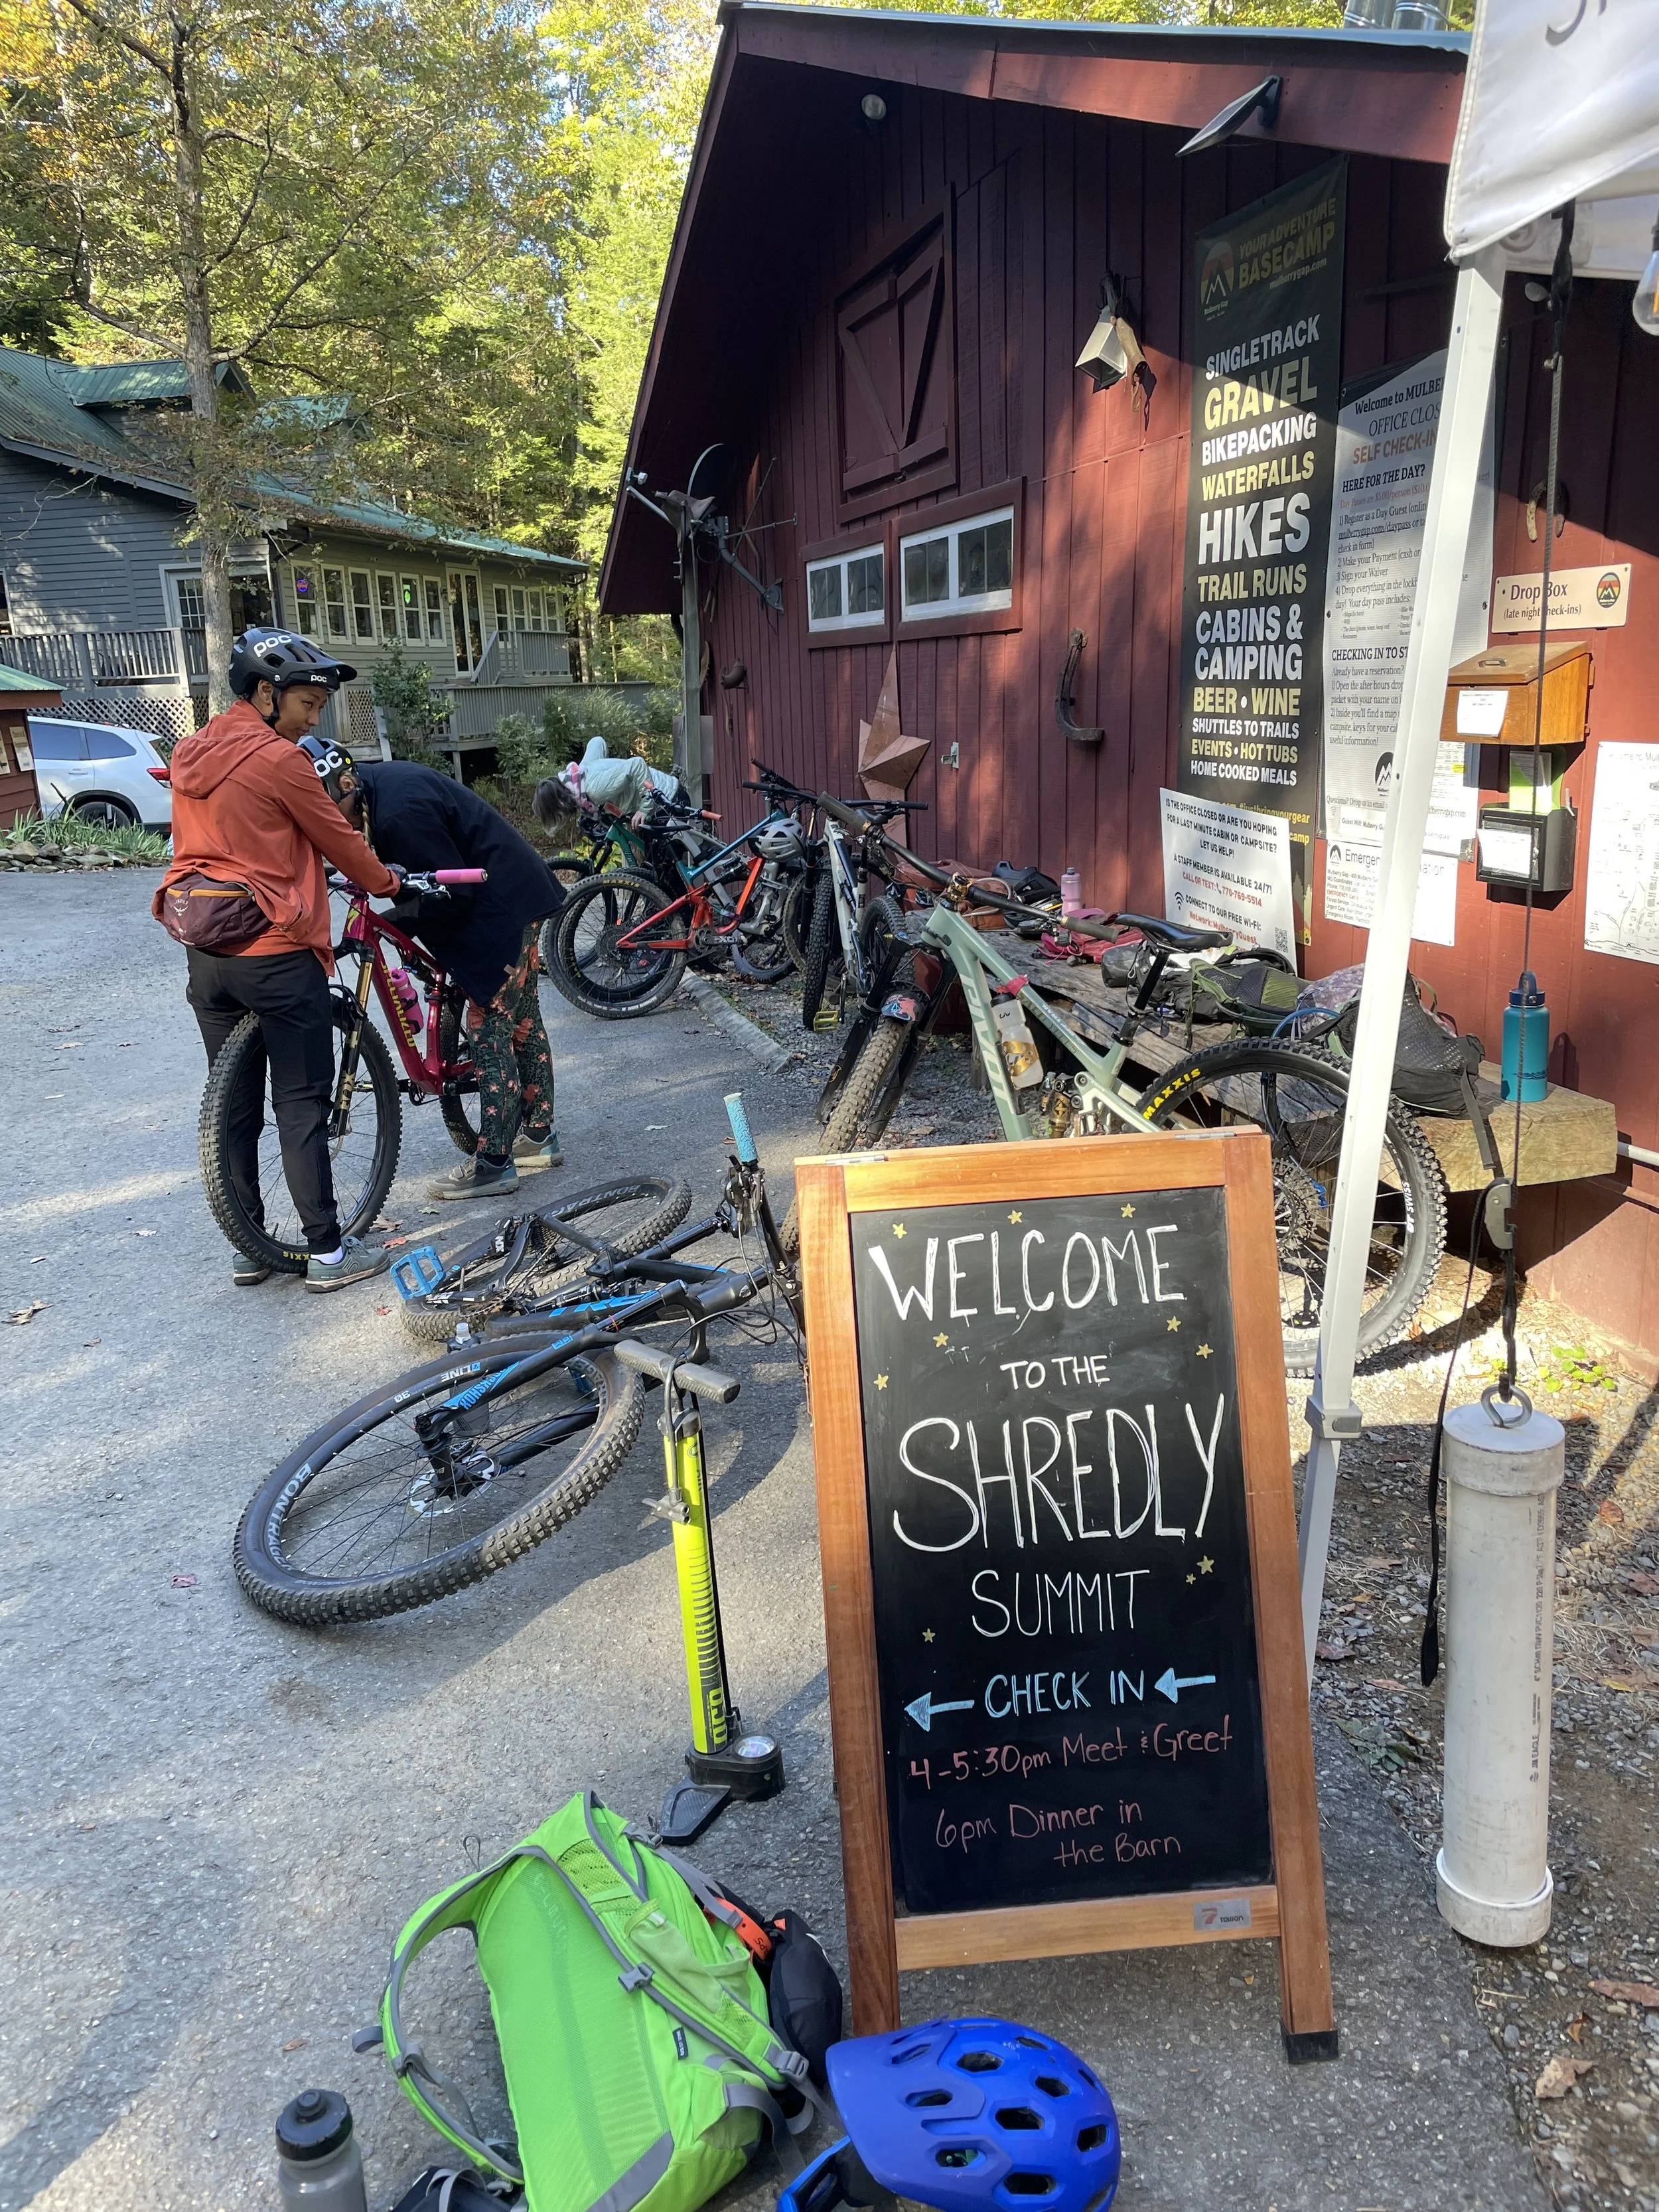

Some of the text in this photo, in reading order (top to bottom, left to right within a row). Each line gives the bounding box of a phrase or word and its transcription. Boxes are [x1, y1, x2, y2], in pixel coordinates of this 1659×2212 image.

[1240, 198, 1336, 259] YOUR ADVENTURE
[1239, 222, 1334, 289] BASECAMP
[1269, 258, 1327, 290] mulberrygap.com
[1206, 314, 1321, 380] SINGLETRACK
[1204, 356, 1317, 430] GRAVEL
[1355, 392, 1404, 415] Welcome to
[1369, 411, 1408, 436] OFFICE
[1202, 411, 1317, 466] BIKEPACKING
[1353, 441, 1381, 465] SELF
[1202, 451, 1315, 501] WATERFALLS
[1342, 464, 1425, 492] HERE FOR THE DAY?
[1340, 499, 1350, 509] Day
[1345, 511, 1363, 526] Register
[1376, 508, 1388, 520] Day
[1389, 506, 1407, 516] Guest
[1198, 492, 1311, 565] HIKES
[1338, 520, 1411, 540] mulberrygap.com/daypass
[1338, 539, 1374, 553] check form)
[1342, 548, 1412, 567] Make your Payment (cash
[1198, 563, 1307, 602] TRAIL RUNS
[1341, 567, 1388, 582] Sign your Waiver
[1341, 579, 1402, 596] Drop everything in the
[1335, 597, 1385, 609] day! Your day pass
[1510, 581, 1568, 605] Drop Box
[1196, 603, 1303, 644] CABINS &
[1504, 605, 1540, 620] (late night
[1195, 643, 1302, 680] CAMPING
[1332, 647, 1398, 660] CHECKING IN TO
[1333, 666, 1351, 678] Already
[1369, 665, 1404, 675] reservation?
[1336, 682, 1349, 692] Open
[1360, 680, 1372, 690] after
[1373, 680, 1390, 690] hours
[1193, 687, 1301, 716] BEER WINE
[1331, 696, 1346, 705] packet
[1347, 694, 1358, 703] with
[1360, 697, 1372, 705] your
[1336, 708, 1397, 721] Inside you'll find map
[1192, 717, 1299, 739] SHUTTLES TO TRAILS
[1344, 736, 1378, 746] information!
[1352, 723, 1366, 733] keys
[1376, 725, 1389, 734] your
[1191, 739, 1297, 764] EVENTS HOT TUBS
[1190, 760, 1297, 786] HOME COOKED MEALS
[1350, 798, 1361, 807] Drop
[1166, 798, 1277, 836] IS THE OFFICE CLOSED OR ARE YOU HOPING
[1181, 818, 1192, 829] LAST
[1194, 822, 1212, 836] MINUTE
[1213, 828, 1230, 841] CABIN
[1231, 833, 1238, 843] OR
[1241, 836, 1277, 853] CAMPSITE?
[1200, 839, 1234, 858] LET US HELP!
[602, 879, 640, 888] MAXXIS
[1178, 856, 1192, 867] STAFF
[1193, 861, 1214, 875] MEMBER
[1214, 868, 1220, 877] IS
[1220, 871, 1252, 889] AVAILABLE
[1254, 881, 1272, 895] 24/7!
[1183, 871, 1262, 907] CALL OR TEXT: 770-769-5514
[1186, 895, 1261, 930] CONNECT TO OUR FREE WI-FI:
[1190, 911, 1212, 927] Network:
[1143, 1068, 1200, 1120] MAXXIS
[1402, 1181, 1415, 1233] SWISS DT
[868, 1224, 1187, 1321] WELCOME
[441, 1364, 472, 1382] LINE
[1000, 1355, 1110, 1390] TO THE
[394, 1390, 410, 1404] 30
[893, 1392, 1224, 1552] SHREDLY
[972, 1569, 1150, 1637] SUMMIT
[985, 1670, 1144, 1718] CHECK IN
[1063, 1727, 1128, 1767] Meet
[1153, 1714, 1233, 1761] Greet
[936, 1799, 1143, 1853] 6pm Dinner in
[1054, 1833, 1181, 1867] the Barn
